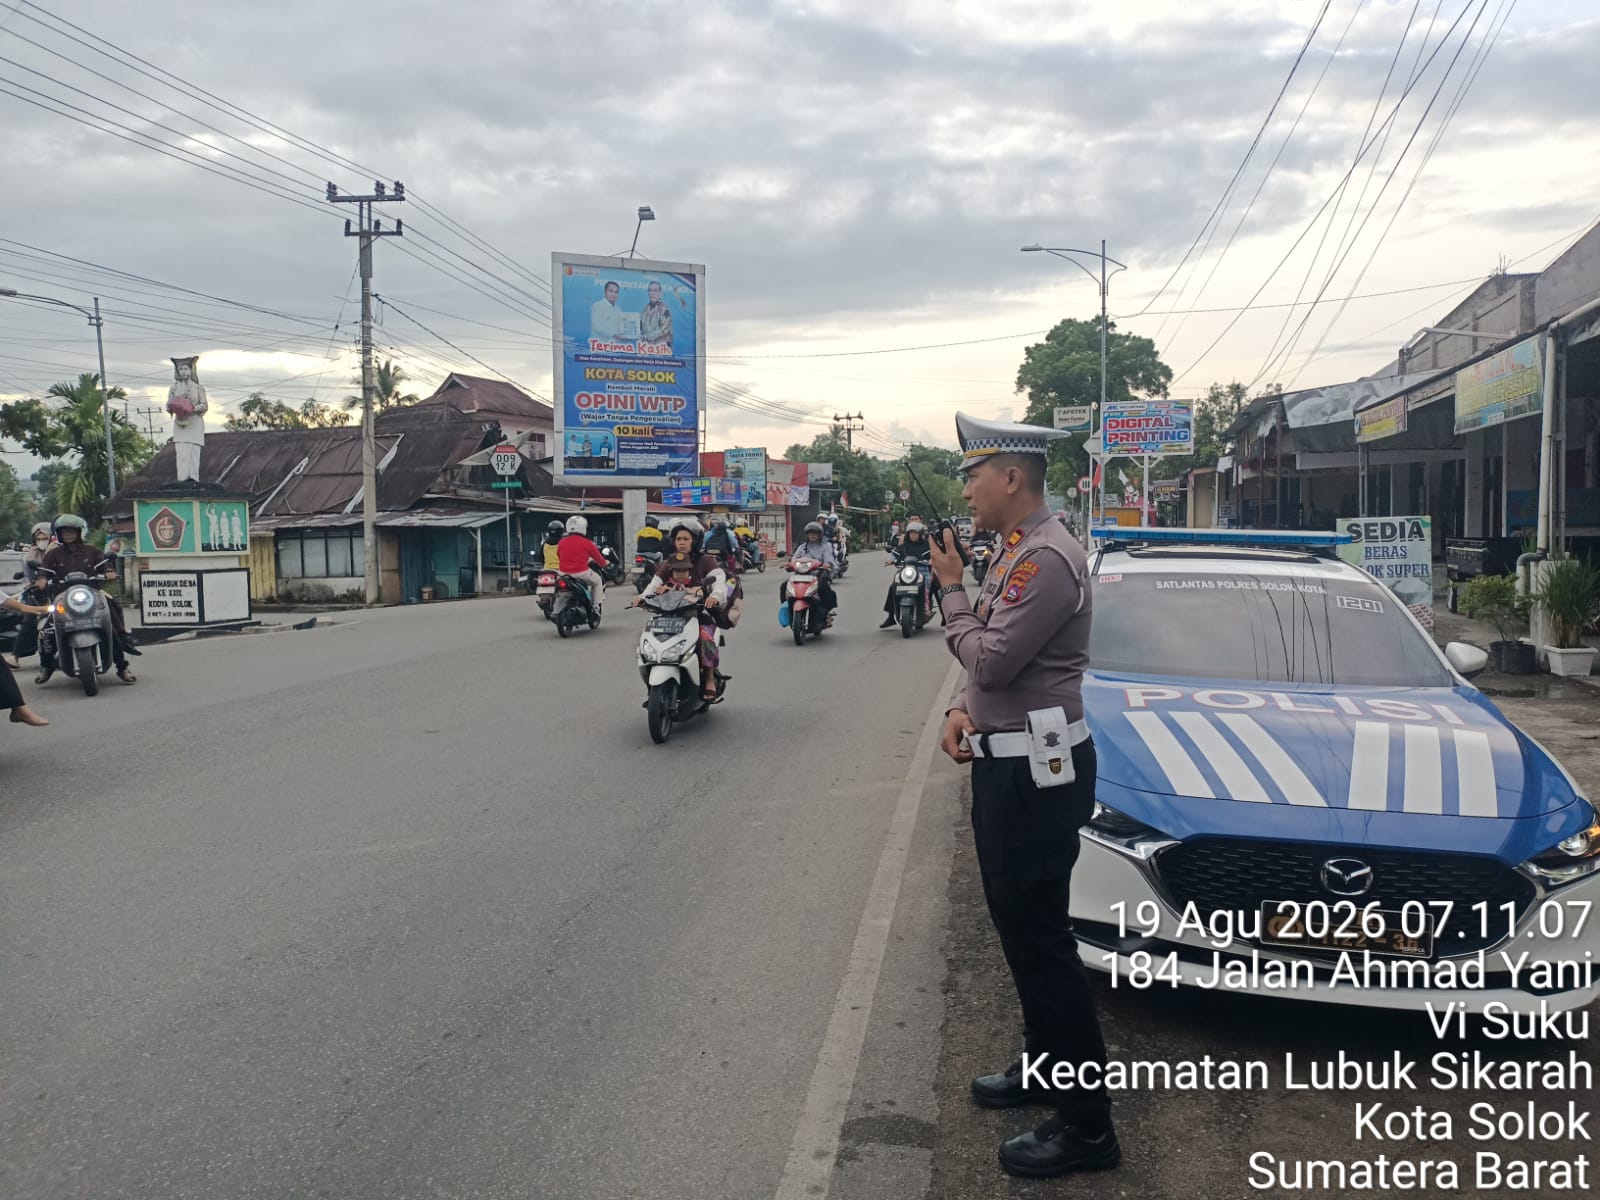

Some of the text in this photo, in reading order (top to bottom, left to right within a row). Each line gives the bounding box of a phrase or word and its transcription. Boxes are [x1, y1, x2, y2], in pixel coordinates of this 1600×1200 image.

[590, 339, 673, 355] Terima Kasih
[585, 368, 676, 383] KOTA SOLOK
[607, 384, 633, 392] Kembali
[576, 392, 686, 412] OPINI WTP
[580, 413, 606, 422] (Wajar
[607, 414, 629, 422] Tanpa
[1107, 416, 1174, 430] DIGITAL
[616, 427, 630, 435] 10
[631, 427, 650, 436] kali
[1107, 430, 1189, 444] PRINTING
[496, 454, 516, 463] 009
[495, 462, 516, 471] 12 K
[1346, 520, 1426, 543] SEDIA
[1364, 545, 1408, 560] BERAS
[1386, 563, 1431, 578] SUPER
[180, 580, 196, 588] DESA
[1156, 580, 1328, 595] SATLANTAS POLRES SOLOK KOTA
[171, 600, 193, 608] SOLOK
[1124, 687, 1465, 726] POLISI
